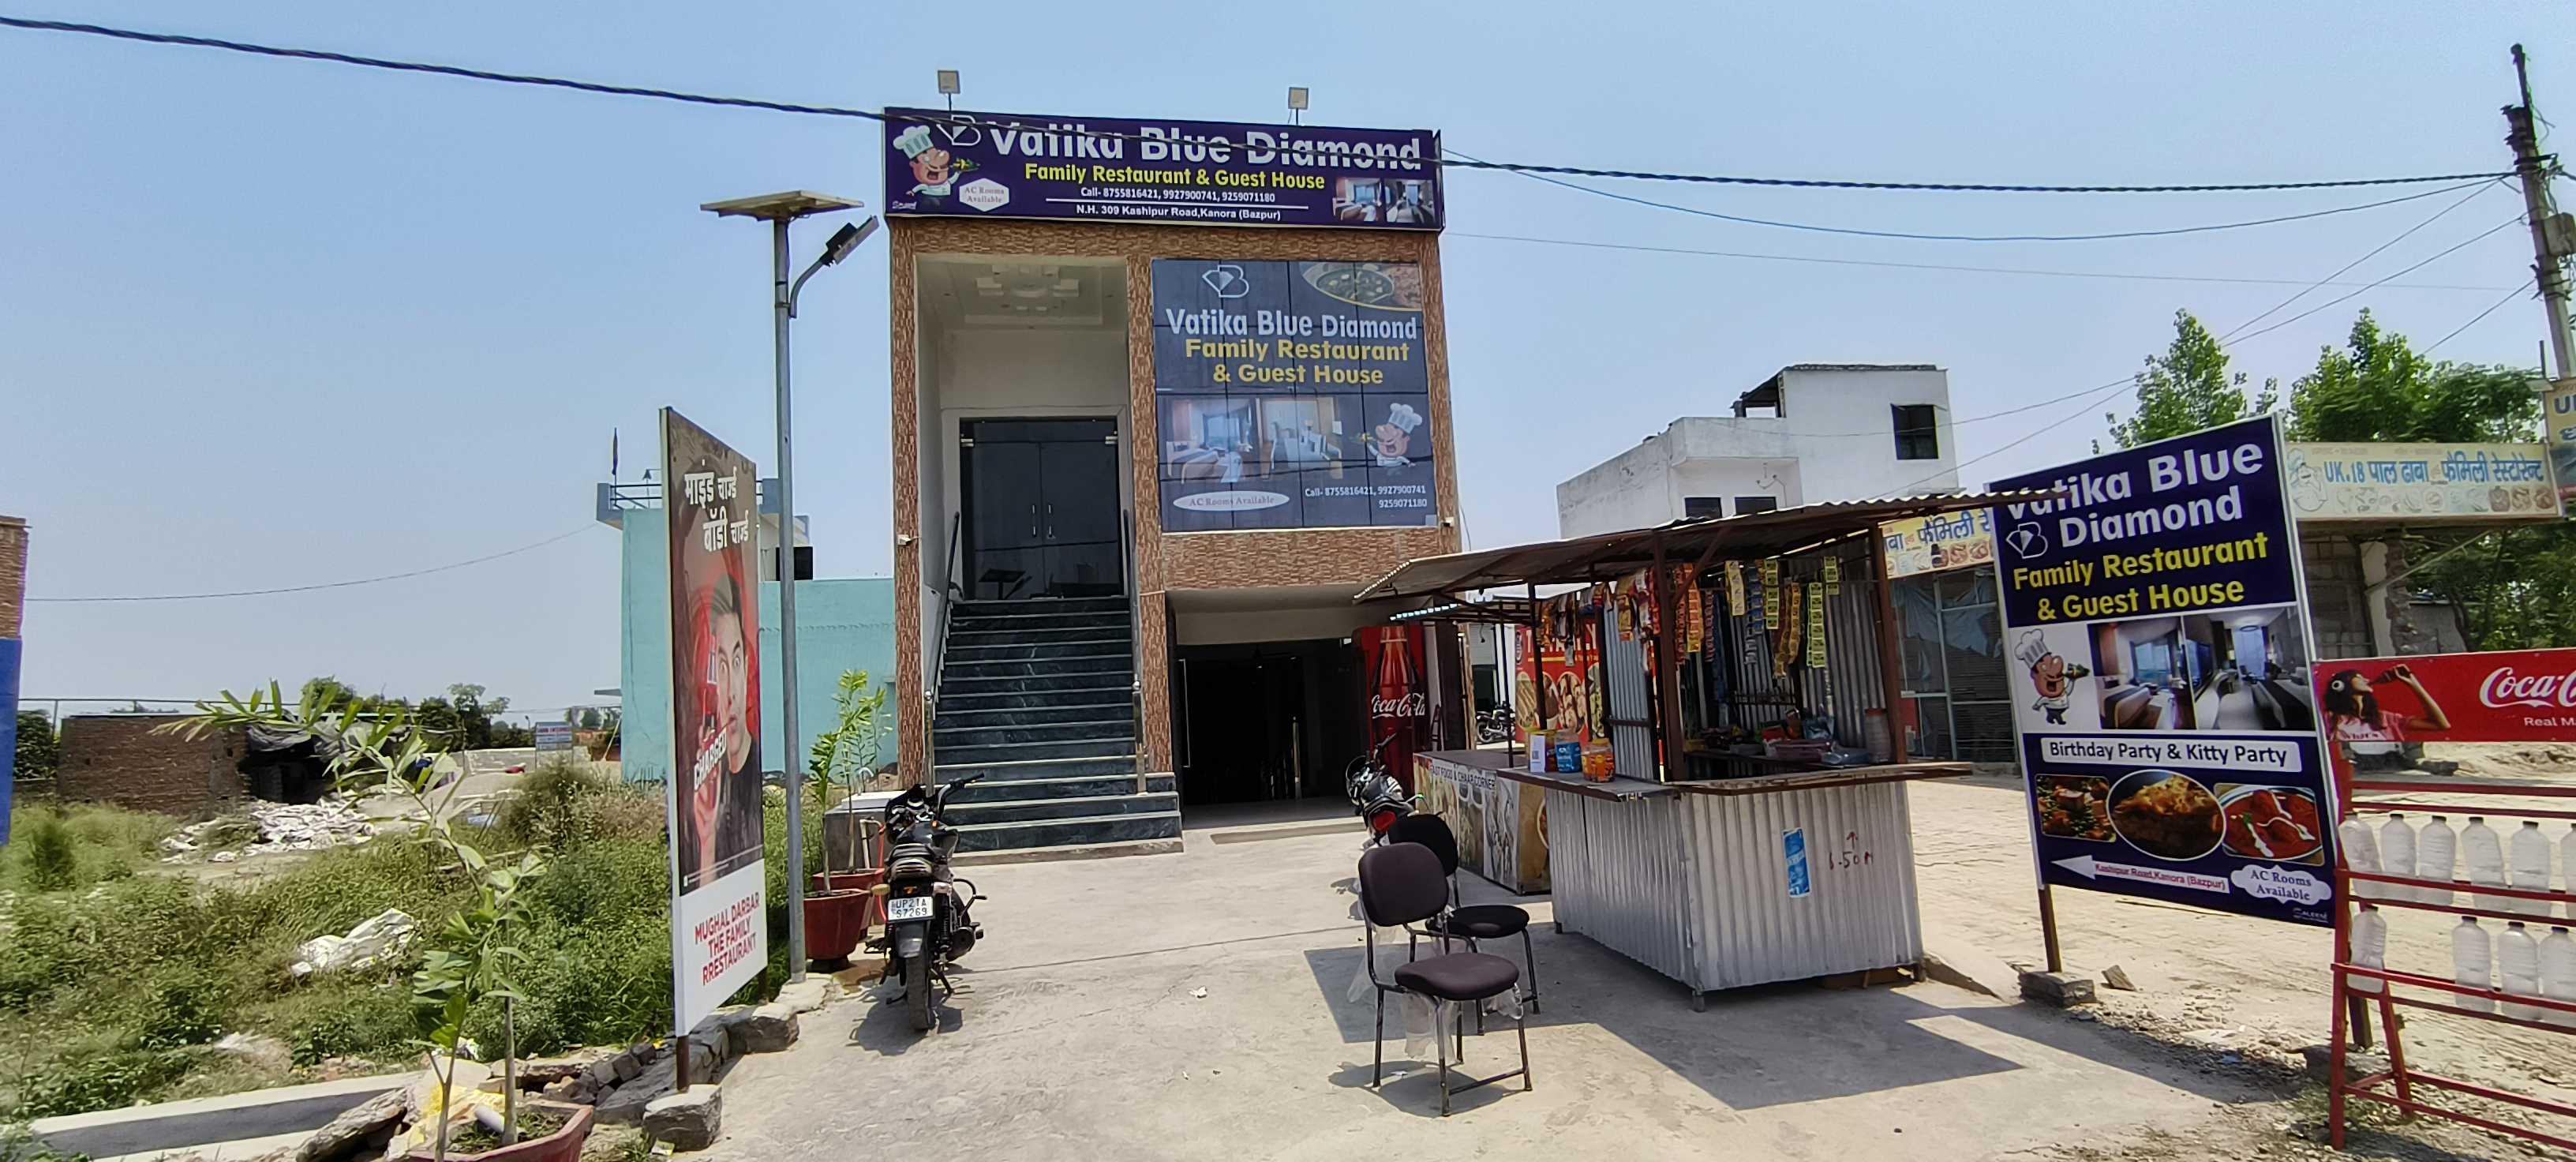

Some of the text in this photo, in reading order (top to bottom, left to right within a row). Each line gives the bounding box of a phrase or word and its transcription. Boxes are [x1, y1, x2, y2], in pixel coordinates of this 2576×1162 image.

[987, 122, 1421, 171] Vatika Blue Diamond
[1025, 163, 1325, 189] Family Restaurant & Guest House
[967, 195, 1002, 204] Available
[1081, 187, 1102, 197] Call-
[1222, 192, 1275, 202] 9259071180
[1076, 205, 1099, 214] N.H.
[1101, 206, 1119, 215] 309
[1122, 206, 1168, 217] Kashipur
[1239, 209, 1280, 221] (Bazpur)
[1166, 309, 1417, 339] Vatika Blue Diamond
[1185, 339, 1410, 362] Family Restaurant
[1213, 364, 1383, 384] & Guest House
[2147, 442, 2264, 493] Blue
[2367, 460, 2398, 484] पाल
[2399, 460, 2429, 484] ढाबा
[1189, 497, 1204, 506] AC
[1236, 496, 1275, 506] Available
[1305, 488, 1324, 497] Call-
[2059, 485, 2243, 547] Diamond
[2012, 531, 2268, 590] Family Restaurant
[2037, 580, 2245, 620] & Guest House
[1371, 692, 1425, 719] Coca-Cola
[2524, 716, 2559, 727] Real
[694, 725, 727, 791] CHARGED
[2050, 741, 2287, 767] Birthday Party & Kitty Party
[2187, 875, 2226, 890] (Bazpur)
[2250, 869, 2312, 886] AC Rooms
[2256, 883, 2311, 901] Available
[695, 891, 759, 945] MUGHAL DARBAR
[896, 907, 927, 918] S7269
[708, 916, 751, 958] THE FAMILY
[702, 932, 756, 986] RRESTAURANT
